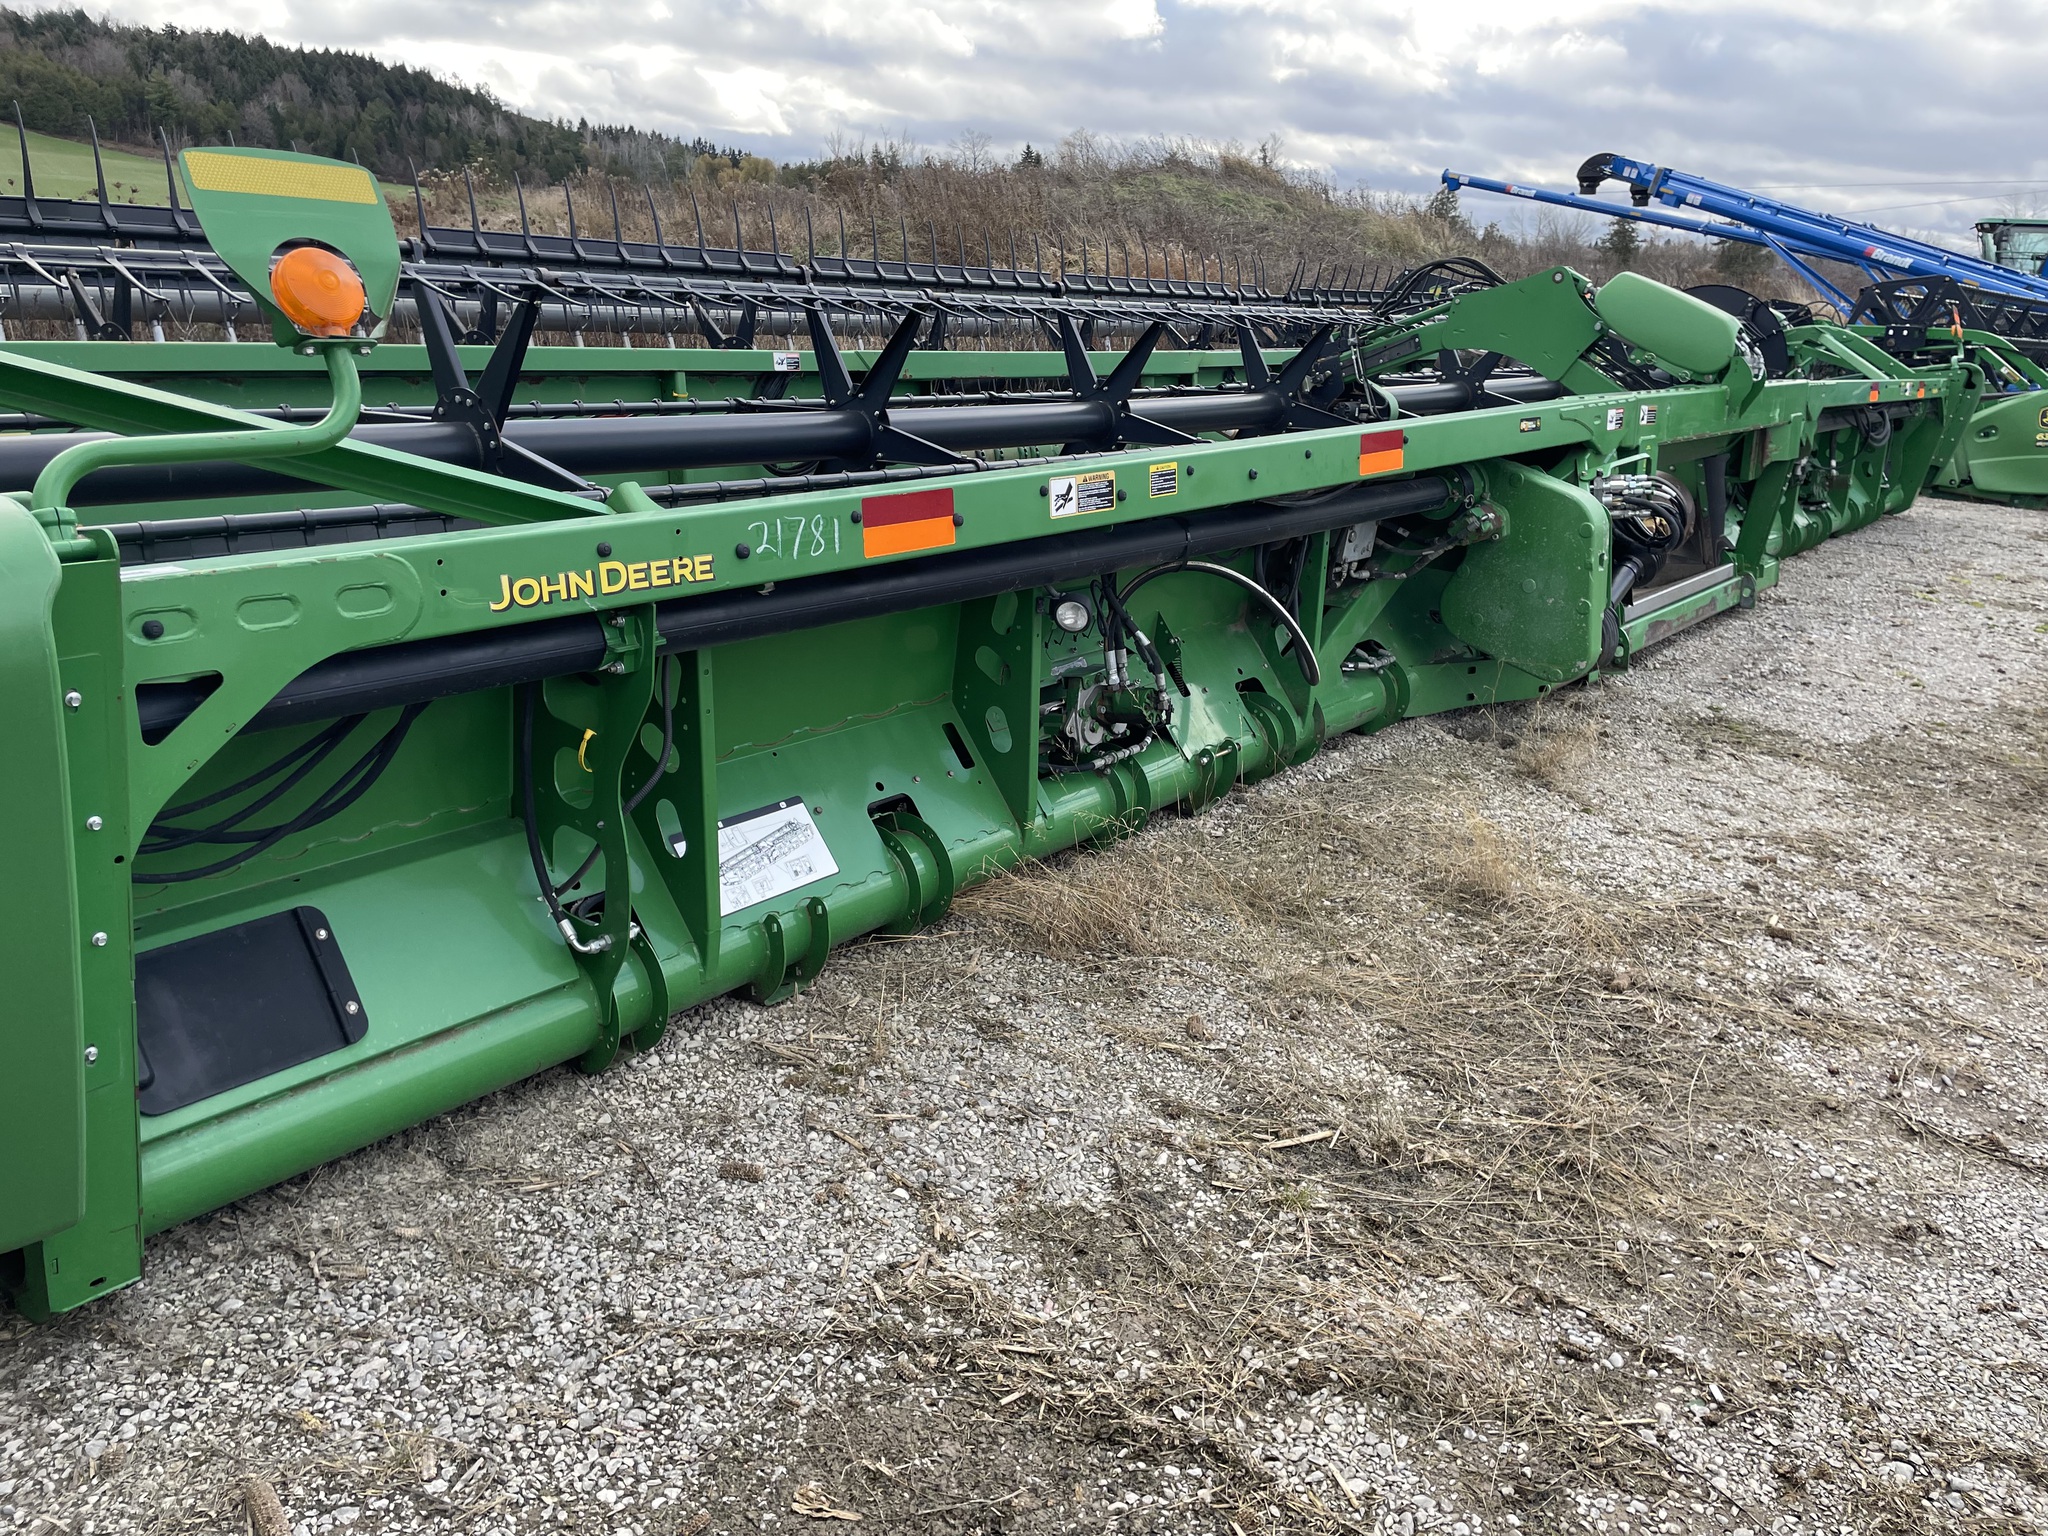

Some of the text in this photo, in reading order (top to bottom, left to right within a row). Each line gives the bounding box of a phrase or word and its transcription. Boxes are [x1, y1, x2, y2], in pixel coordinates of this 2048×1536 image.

[1871, 248, 1914, 269] Brandt
[1088, 473, 1109, 482] WARNING
[747, 513, 840, 560] 21781
[489, 554, 715, 612] JOHN DEERE
